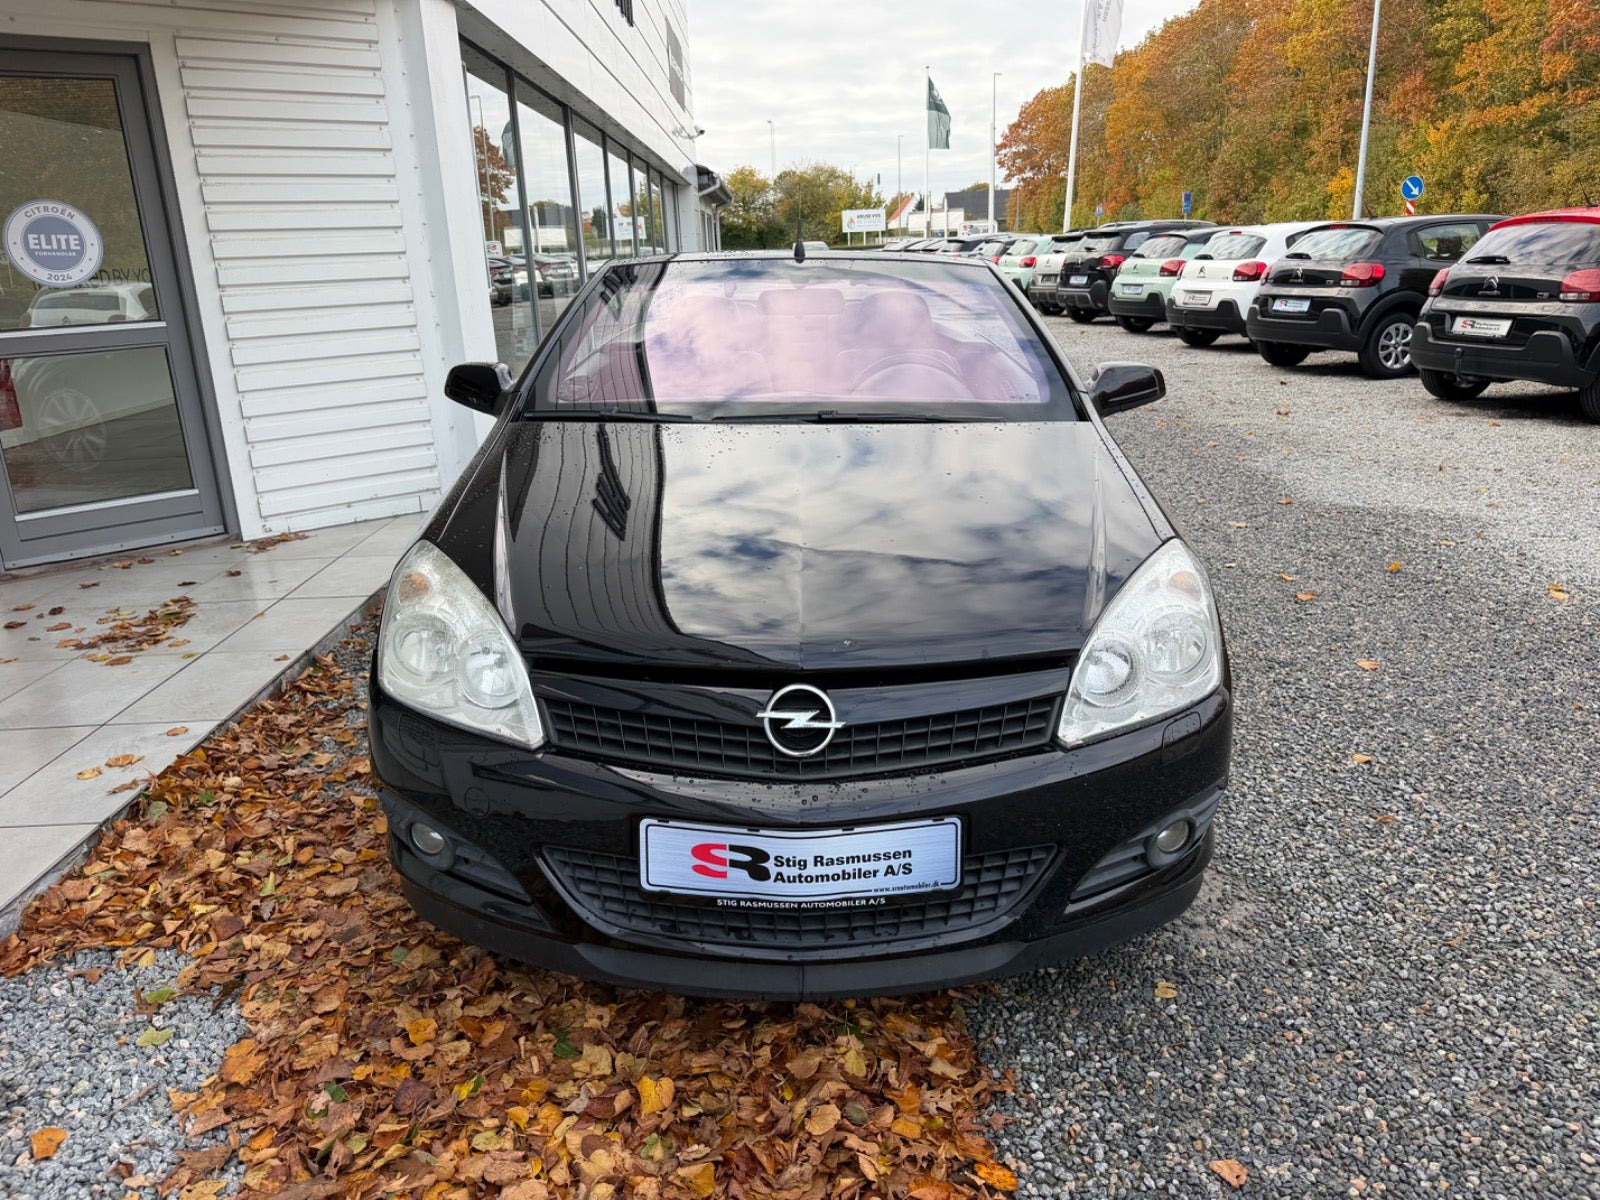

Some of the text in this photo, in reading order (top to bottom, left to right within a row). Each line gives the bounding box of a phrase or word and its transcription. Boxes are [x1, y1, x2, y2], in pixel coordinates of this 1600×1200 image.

[24, 205, 75, 220] CITROËN
[28, 234, 81, 250] ELITE
[774, 849, 912, 870] Stig Rasmussen
[773, 862, 913, 884] Automobiler A/S
[740, 900, 798, 909] RASMUSSEN
[800, 898, 867, 909] AUTOMOBILER
[868, 898, 886, 906] A/S
